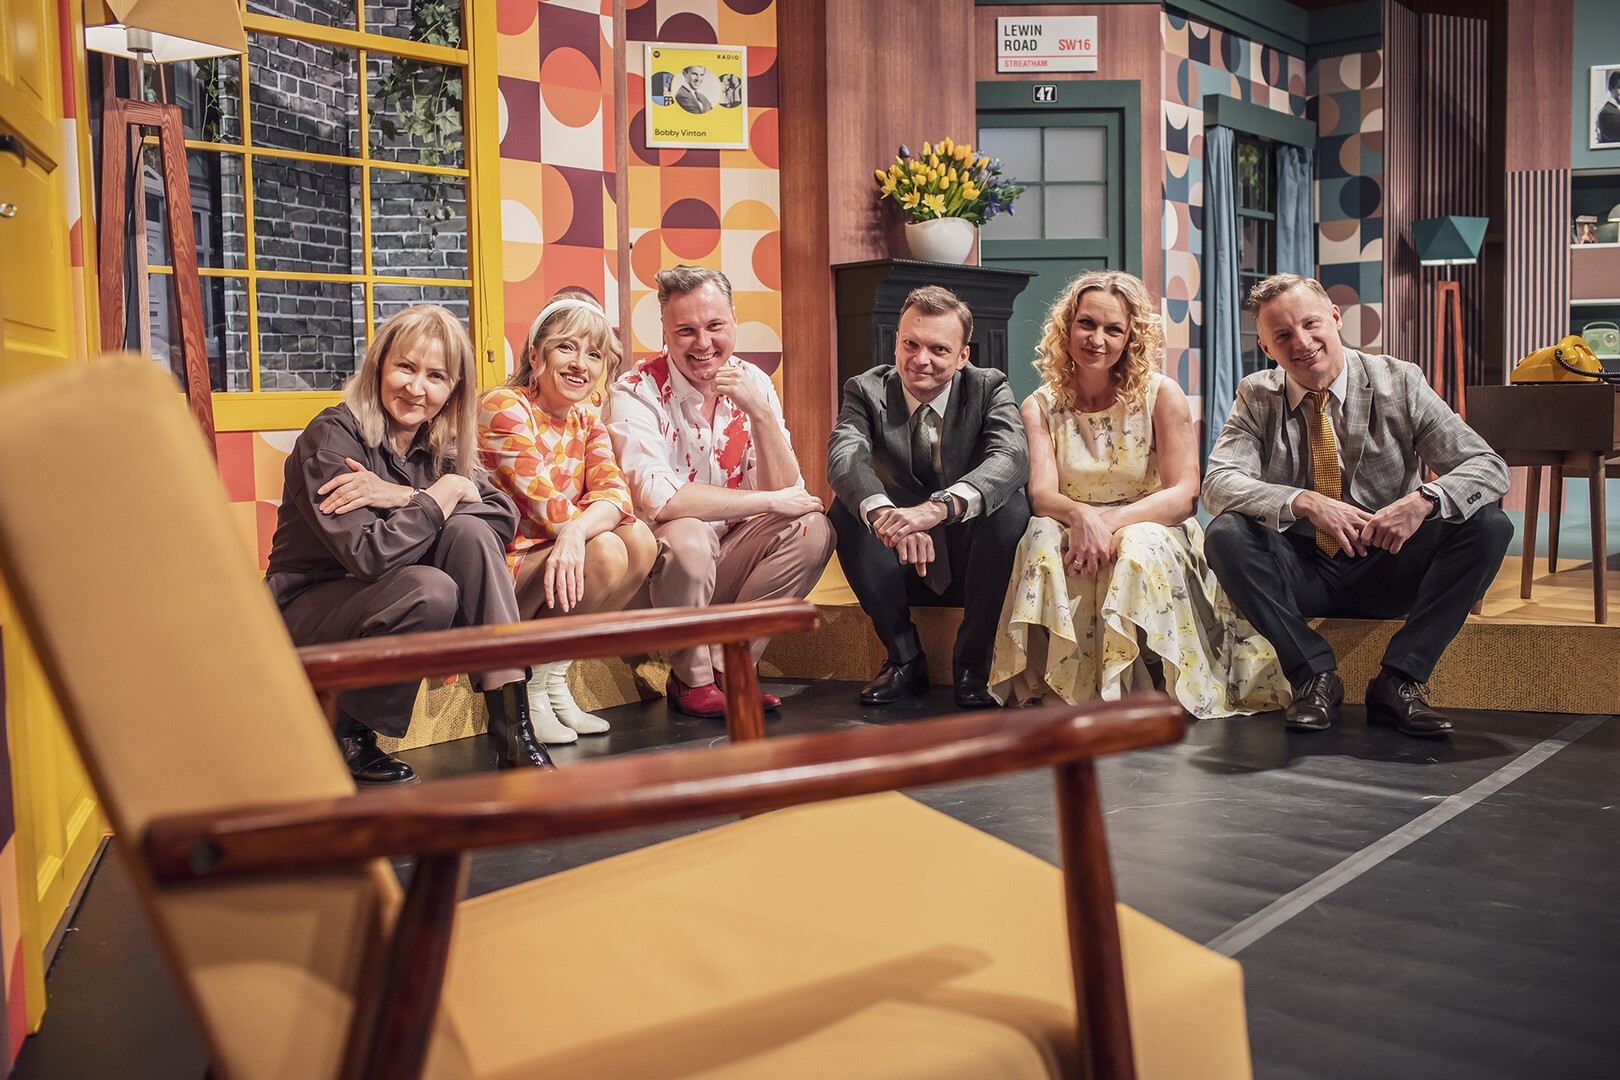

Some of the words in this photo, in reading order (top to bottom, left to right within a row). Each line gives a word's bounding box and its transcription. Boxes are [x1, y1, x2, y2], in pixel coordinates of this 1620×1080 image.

[1004, 24, 1042, 36] LEWIN
[1004, 39, 1037, 51] ROAD
[1058, 39, 1091, 50] SW16
[1037, 87, 1053, 101] 47
[655, 128, 679, 137] Bobby
[681, 129, 706, 137] Vinton
